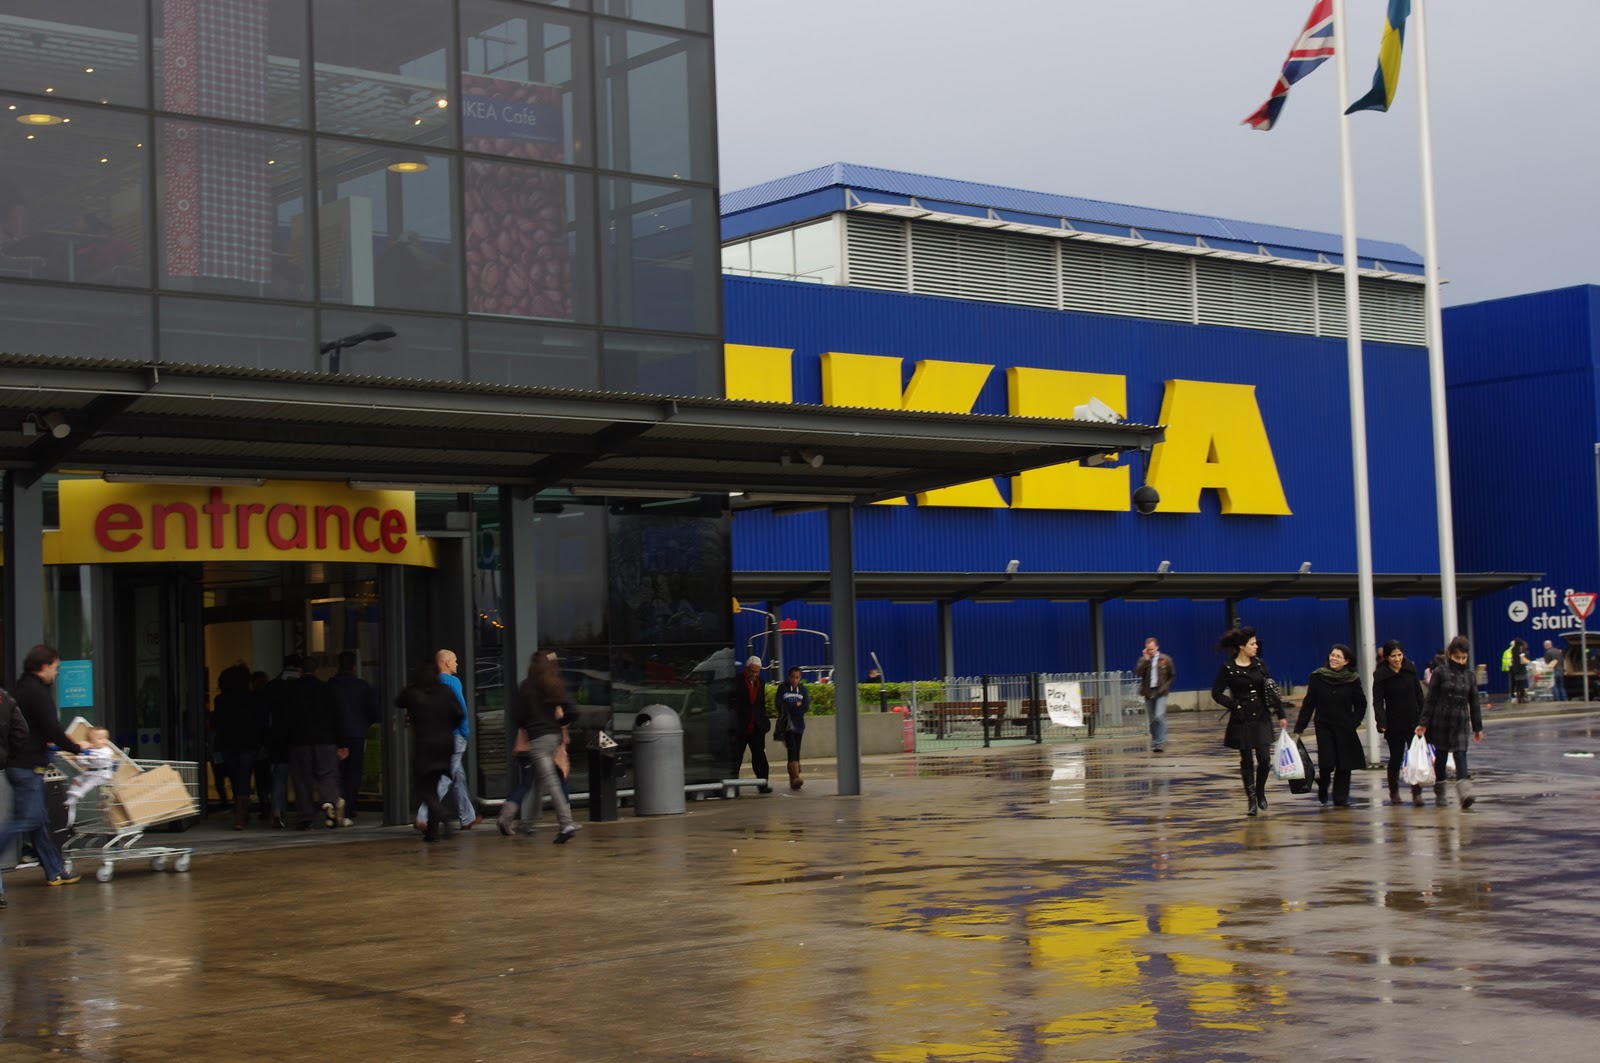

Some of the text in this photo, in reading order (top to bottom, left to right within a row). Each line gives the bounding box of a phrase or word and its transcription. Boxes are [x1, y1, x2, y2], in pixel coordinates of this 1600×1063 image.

[463, 100, 536, 126] IKEA Café
[95, 486, 408, 554] entrance
[1532, 587, 1557, 608] lift
[1532, 609, 1583, 630] stairs
[1047, 688, 1066, 701] Play
